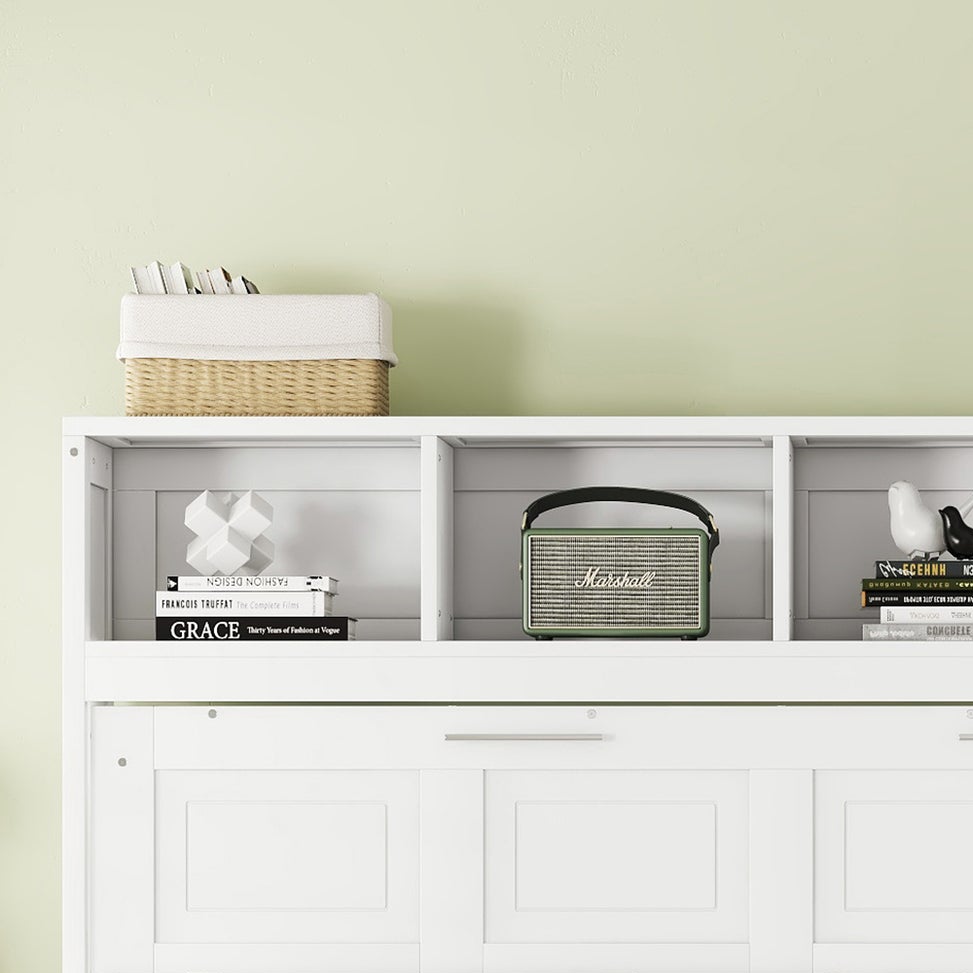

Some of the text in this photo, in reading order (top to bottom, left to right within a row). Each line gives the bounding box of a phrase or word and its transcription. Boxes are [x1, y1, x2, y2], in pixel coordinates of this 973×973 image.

[207, 576, 243, 587] DESIGN
[246, 576, 288, 587] FASHION
[575, 567, 656, 588] Marshall
[161, 599, 233, 609] FRANCOIS TRUFFAT
[170, 621, 240, 639] GRACE
[247, 626, 266, 635] Thirty
[266, 626, 282, 634] Years
[283, 626, 290, 634] of
[290, 626, 313, 634] Fashion
[321, 626, 340, 635] Vogue
